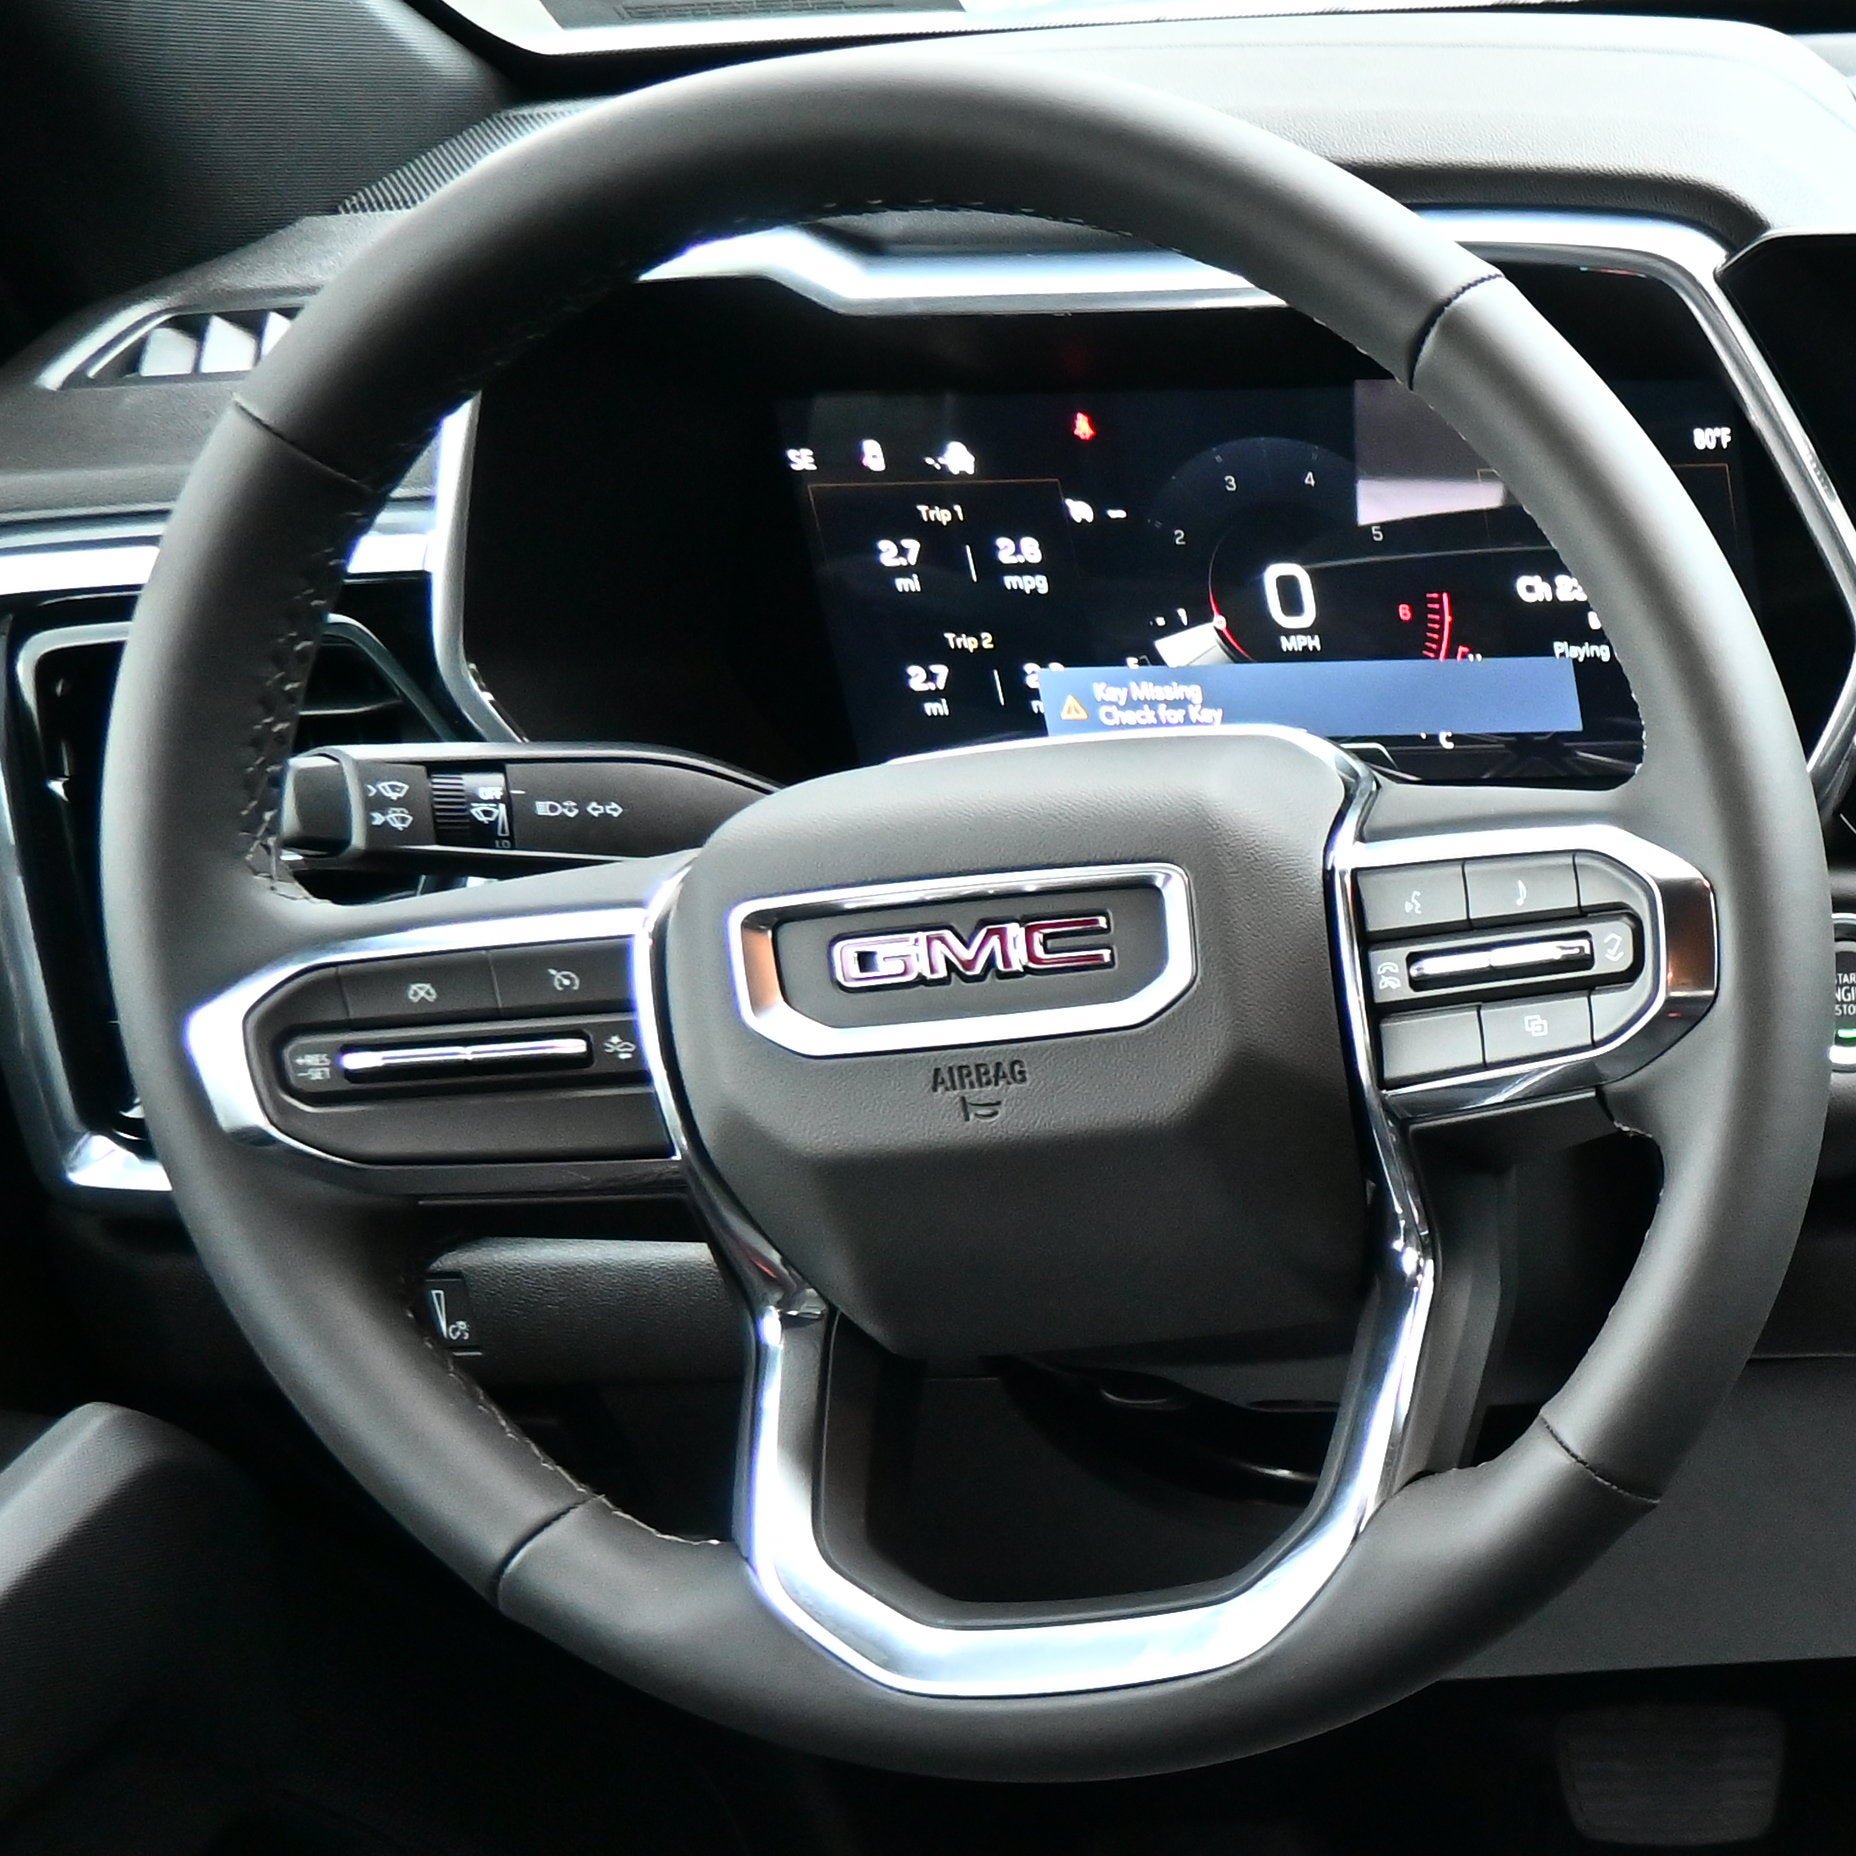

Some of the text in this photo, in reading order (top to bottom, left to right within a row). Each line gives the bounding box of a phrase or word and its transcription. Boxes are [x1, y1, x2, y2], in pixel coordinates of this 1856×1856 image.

[1224, 475, 1237, 492] 3
[1304, 471, 1316, 488] 4
[916, 504, 964, 526] Trip 1
[1173, 529, 1186, 545] 2
[1371, 525, 1384, 542] 5
[877, 538, 921, 567] 2.7
[894, 574, 921, 593] mi
[1003, 575, 1049, 594] mpg
[1263, 562, 1316, 629] 0
[943, 632, 994, 653] Trip 2
[1280, 634, 1321, 652] MPH
[1553, 641, 1611, 663] Playing
[906, 663, 949, 692] 2.7
[1093, 682, 1128, 706] Key
[1130, 681, 1204, 705] Missing
[923, 698, 950, 717] mi
[1099, 703, 1223, 726] Check for Key
[832, 914, 1113, 990] GMC
[931, 1060, 1027, 1093] AIRBAG
